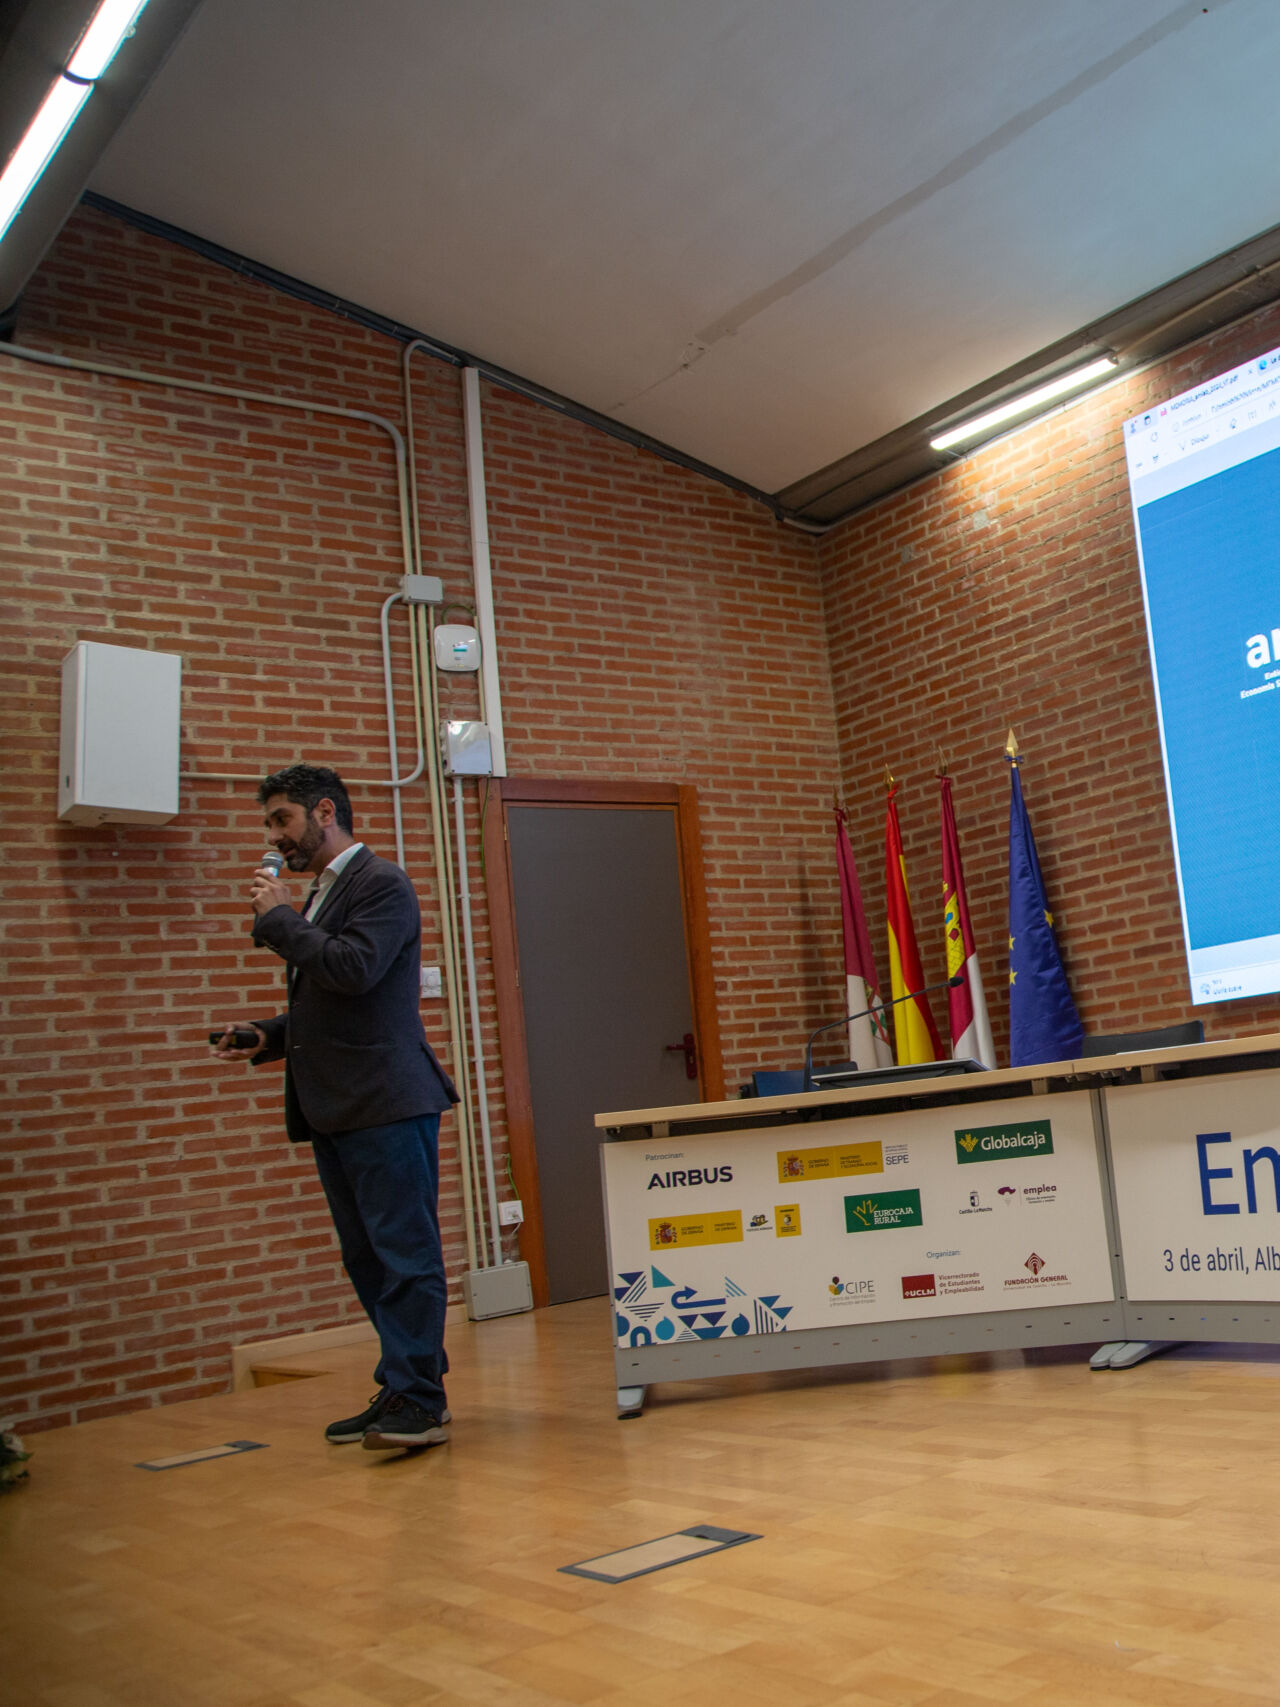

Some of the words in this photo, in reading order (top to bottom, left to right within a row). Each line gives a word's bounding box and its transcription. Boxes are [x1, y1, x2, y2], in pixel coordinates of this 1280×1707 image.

[980, 1132, 1046, 1151] Globalcaja
[645, 1152, 684, 1161] Patrocinan:
[885, 1154, 909, 1166] SEPE
[647, 1166, 733, 1190] AIRBUS
[1023, 1184, 1057, 1195] emplea
[873, 1206, 914, 1218] EUROCAJA
[874, 1215, 901, 1225] RURAL
[926, 1250, 961, 1259] Organizan:
[1163, 1249, 1174, 1272] 3
[1180, 1248, 1201, 1272] de
[1207, 1247, 1249, 1275] abril,
[938, 1272, 980, 1281] Vicerrectorado
[1004, 1276, 1039, 1286] FUNDACIÓN
[1040, 1274, 1069, 1283] GENERAL
[845, 1280, 875, 1295] CIPE
[947, 1279, 980, 1287] Estudiantes
[910, 1289, 935, 1297] UCLM
[944, 1285, 985, 1295] Empleabilidad
